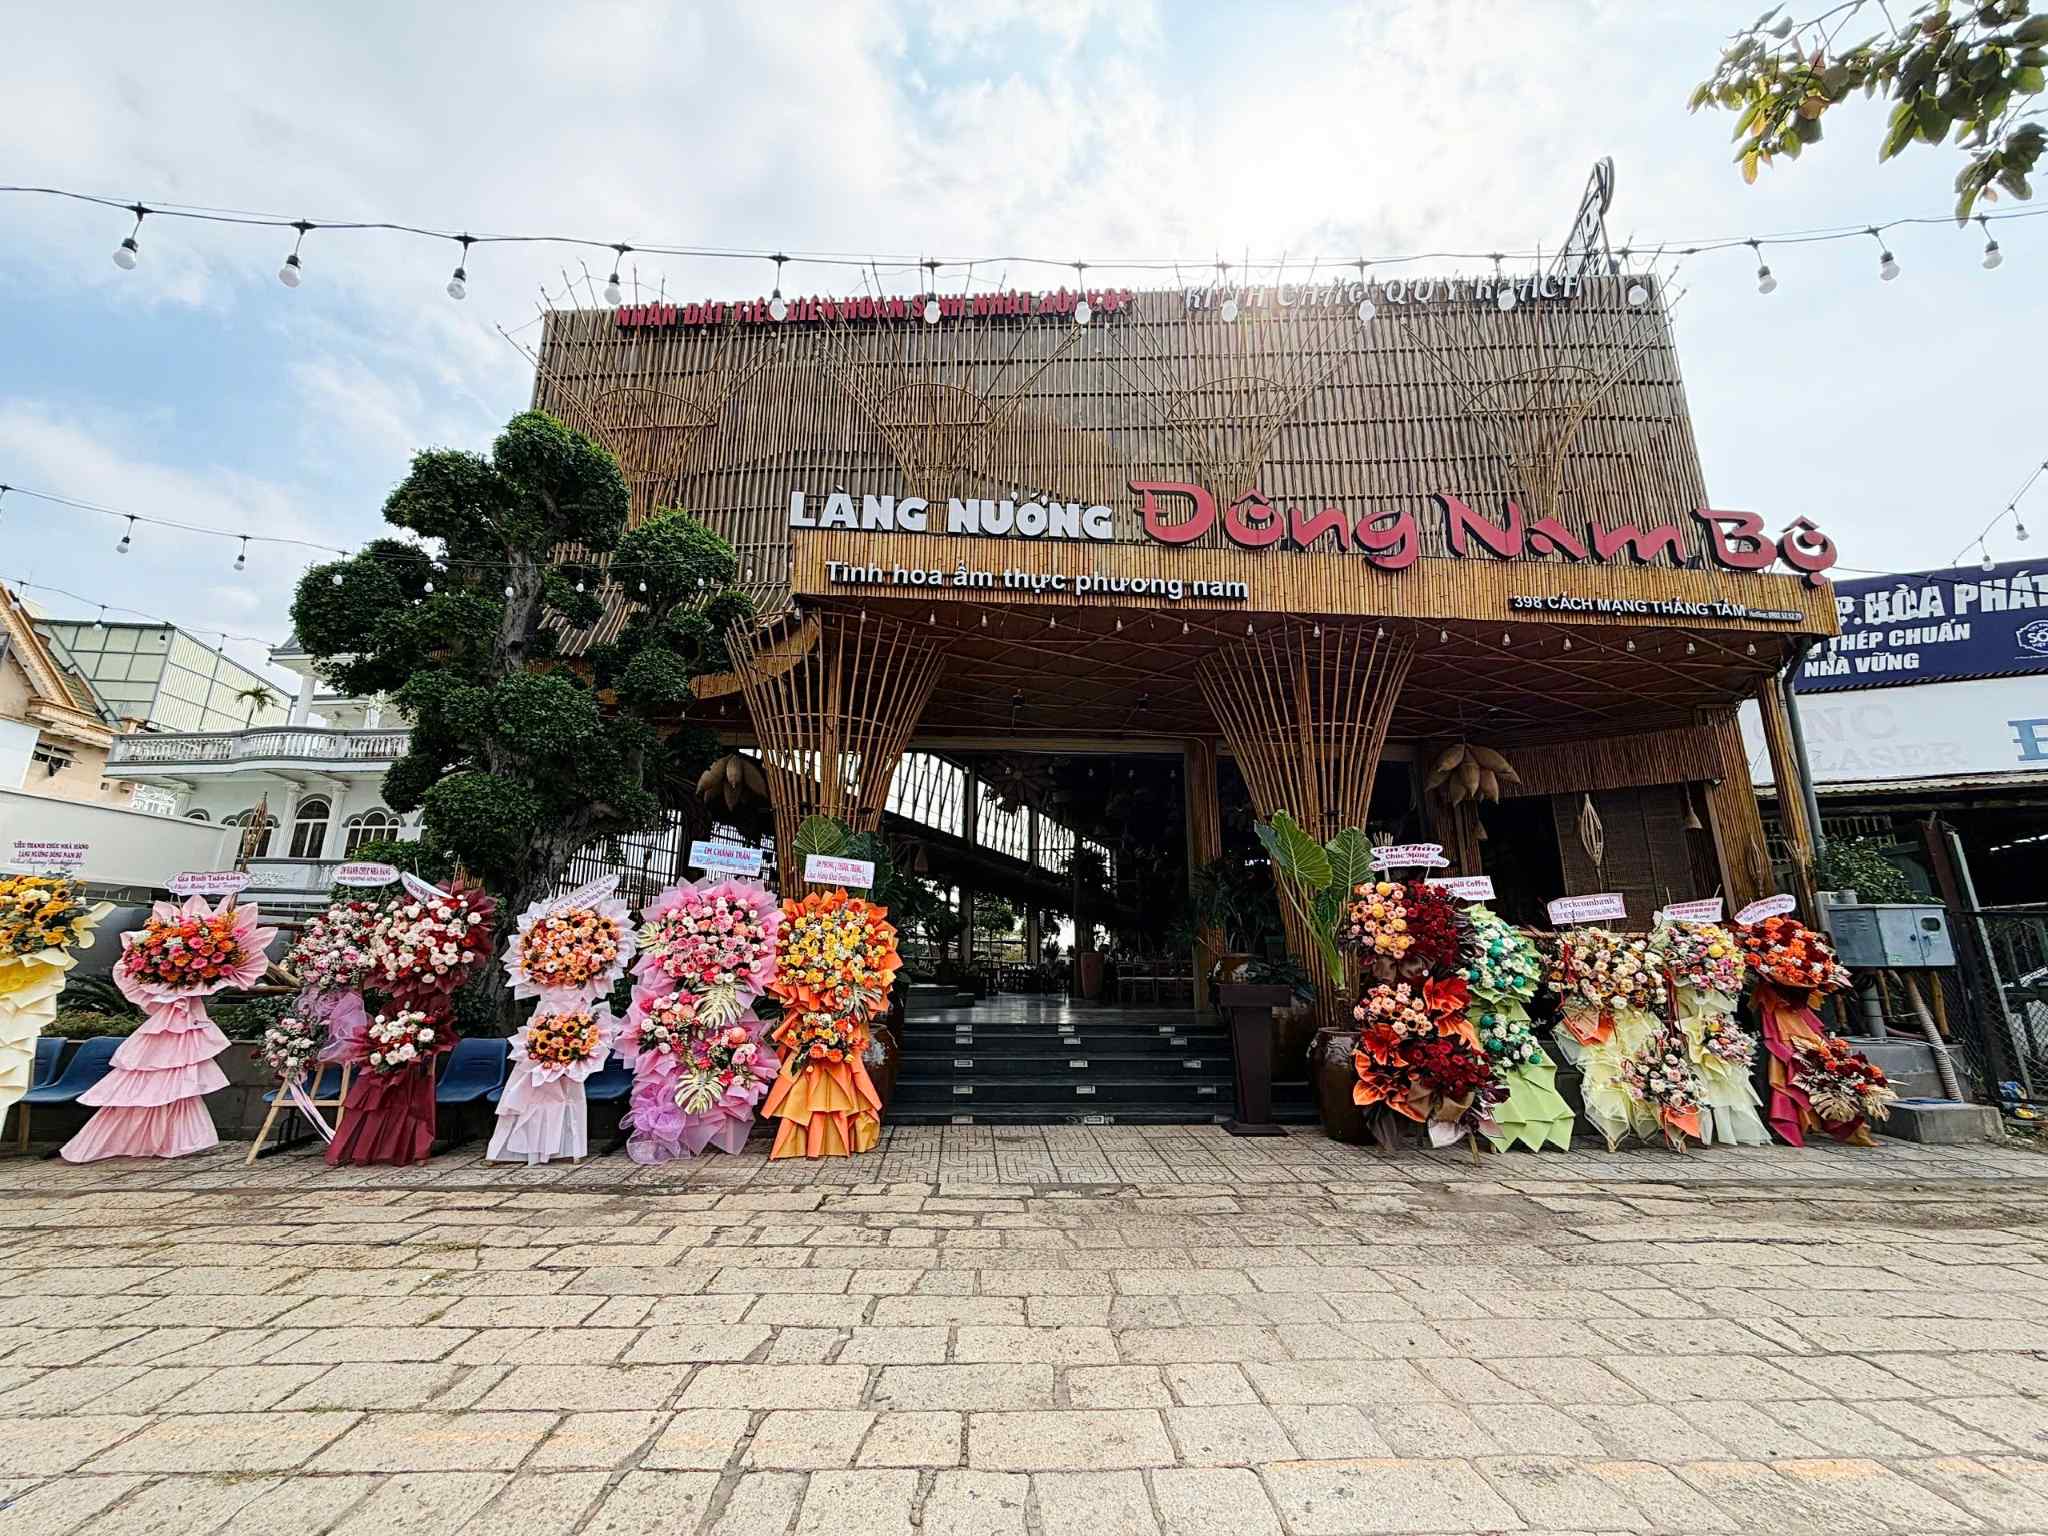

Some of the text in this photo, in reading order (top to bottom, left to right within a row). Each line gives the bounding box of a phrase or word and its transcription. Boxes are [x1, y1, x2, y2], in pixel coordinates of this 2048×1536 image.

[911, 291, 966, 317] SNH
[789, 479, 1840, 587] LÀNG NƯỚNG Đông Nam Bộ
[825, 560, 883, 585] Tinh
[892, 564, 943, 586] hoa
[1003, 567, 1067, 595] thực
[1076, 575, 1184, 599] phương
[1193, 577, 1249, 599] nam
[1514, 595, 1542, 608] 398
[1547, 591, 1593, 611] CÁCH
[1597, 598, 1647, 616] MẠNG
[1651, 595, 1709, 616] THÁNG
[1829, 628, 1883, 651] THÉP
[1804, 655, 1851, 677] NHÀ
